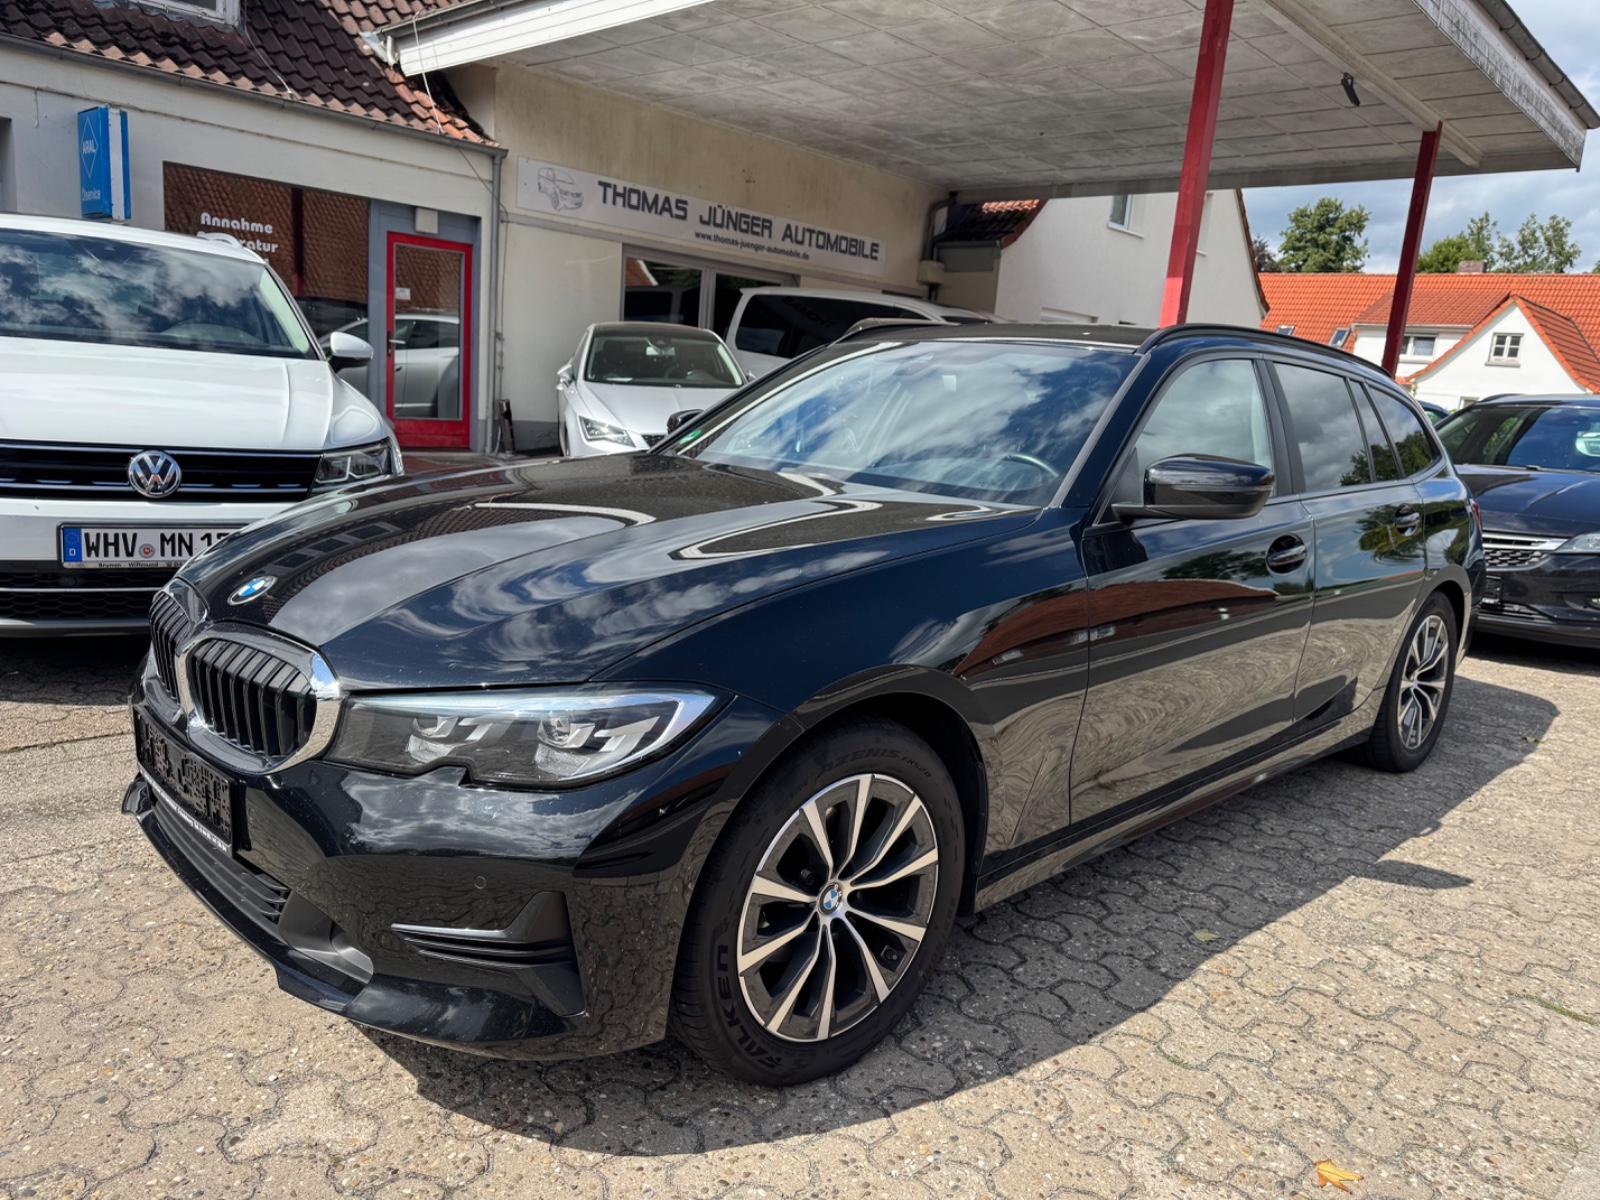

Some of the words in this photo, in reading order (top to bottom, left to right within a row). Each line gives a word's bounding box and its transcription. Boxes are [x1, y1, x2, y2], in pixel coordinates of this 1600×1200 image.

[200, 212, 273, 234] Annahme
[598, 180, 688, 221] THOMAS
[699, 204, 773, 240] JÜNGER
[781, 223, 880, 261] AUTOMOBILE
[694, 230, 810, 261] www.thomas-juenger-automobile.de
[84, 532, 138, 558] WHV
[160, 532, 194, 558] MN
[200, 532, 230, 547] 1
[717, 944, 783, 1069] FALKEN
